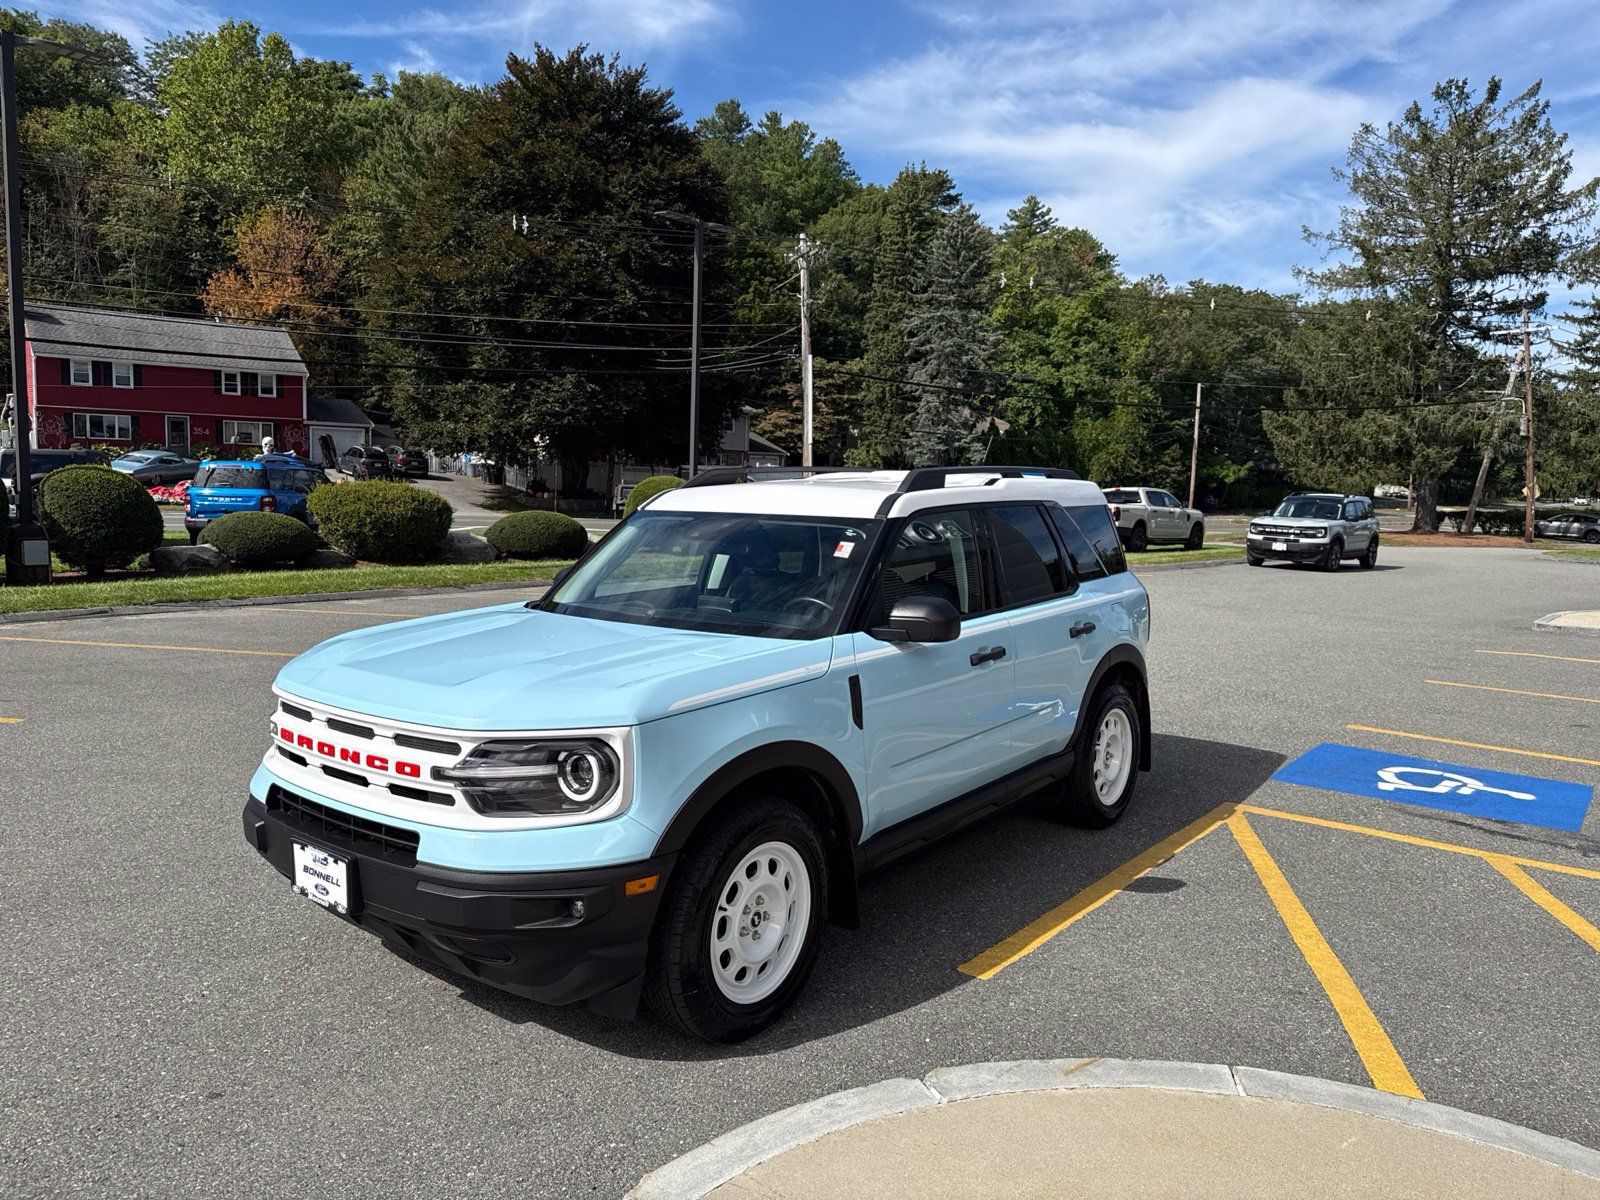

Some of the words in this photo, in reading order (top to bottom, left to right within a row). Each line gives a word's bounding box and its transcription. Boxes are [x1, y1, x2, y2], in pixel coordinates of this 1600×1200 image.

[192, 427, 210, 435] 354
[280, 727, 421, 778] BRONCO
[303, 864, 341, 887] BONNELL
